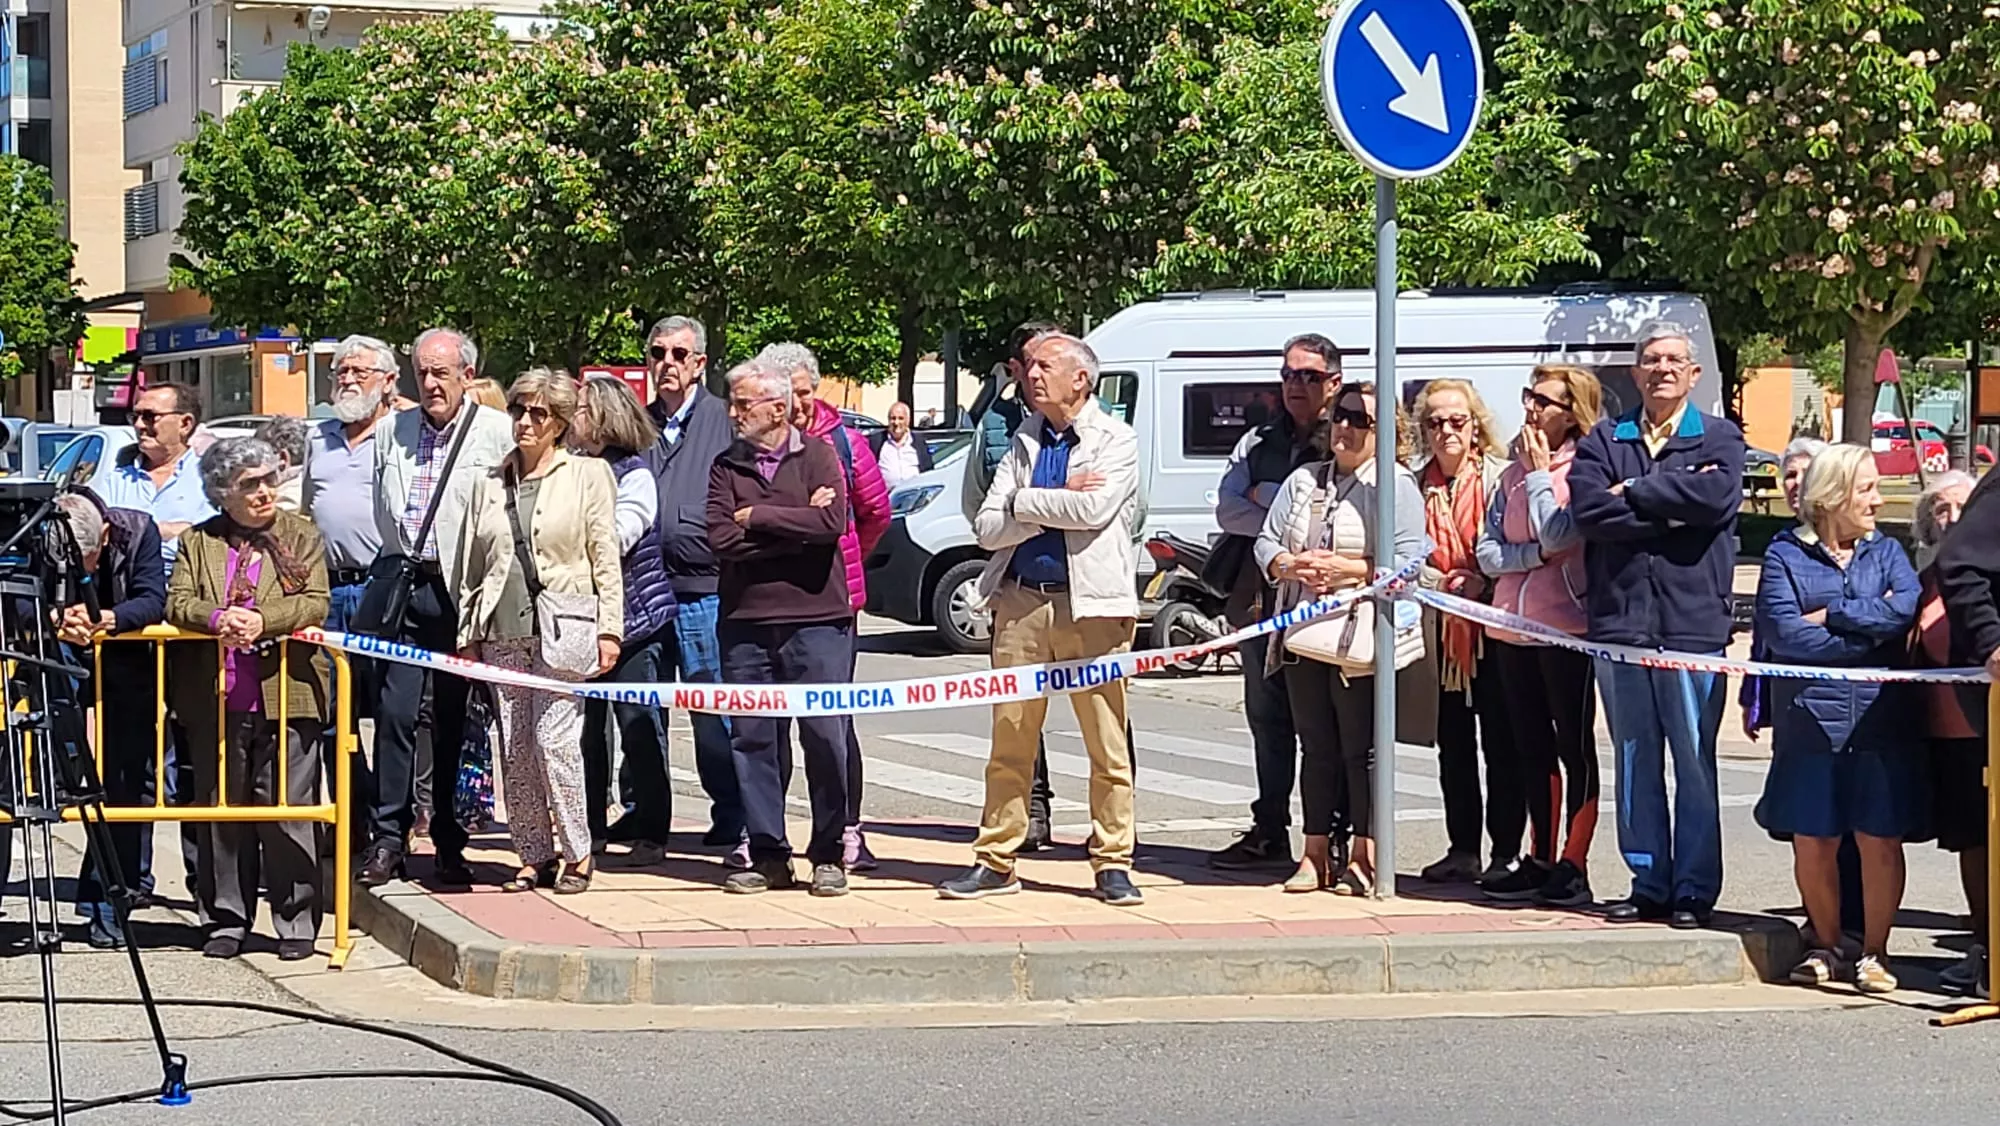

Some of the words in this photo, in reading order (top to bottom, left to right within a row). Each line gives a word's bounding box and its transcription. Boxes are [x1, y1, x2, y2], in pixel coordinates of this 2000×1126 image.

[343, 631, 432, 662] POLICIA
[675, 689, 705, 709] NO
[713, 689, 788, 710] PASAR
[805, 688, 894, 710] POLICIA
[906, 683, 936, 704] NO
[944, 674, 1019, 700] PASAR
[1035, 662, 1124, 692] POLICIA
